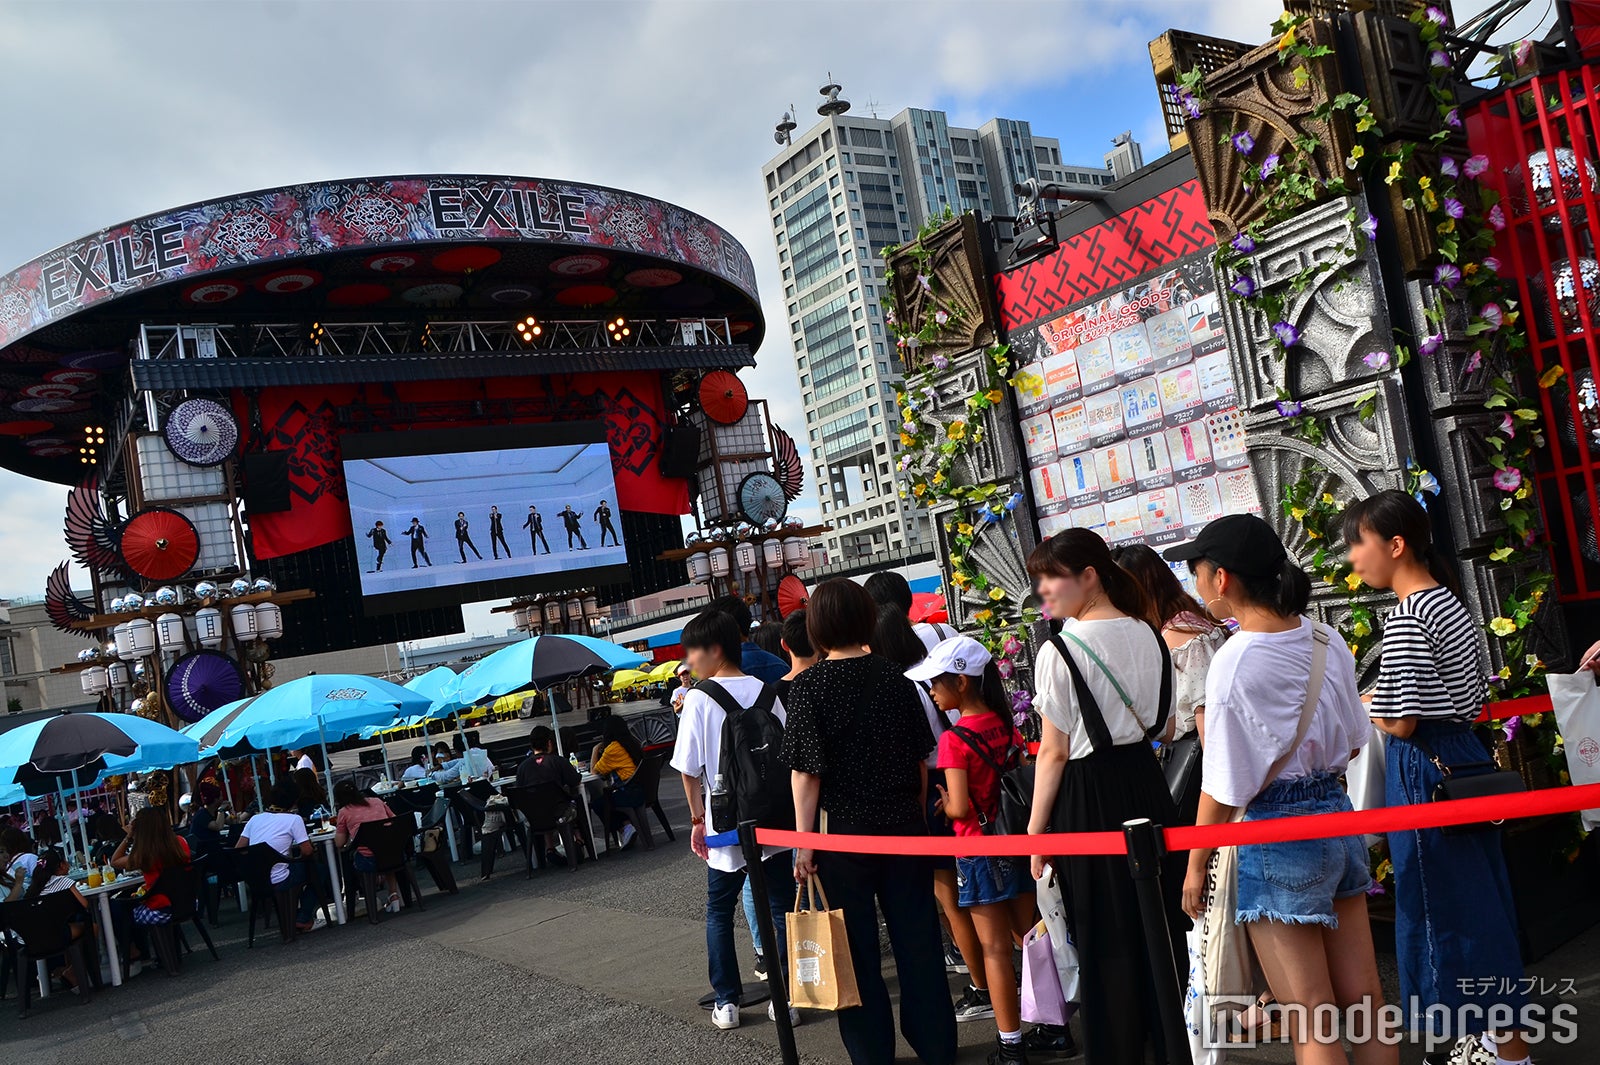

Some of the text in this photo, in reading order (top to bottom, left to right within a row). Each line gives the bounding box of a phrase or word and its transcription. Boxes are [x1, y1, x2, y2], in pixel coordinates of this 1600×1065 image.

[427, 188, 591, 235] EXILE
[42, 221, 189, 309] EXILE
[1052, 288, 1170, 342] ORIGINAL GOODS
[1086, 314, 1139, 340] オリジナルグッズ
[1208, 395, 1237, 408] マスキングテー
[1143, 476, 1167, 486] キーホルダー
[1181, 466, 1206, 477] キーホルダー
